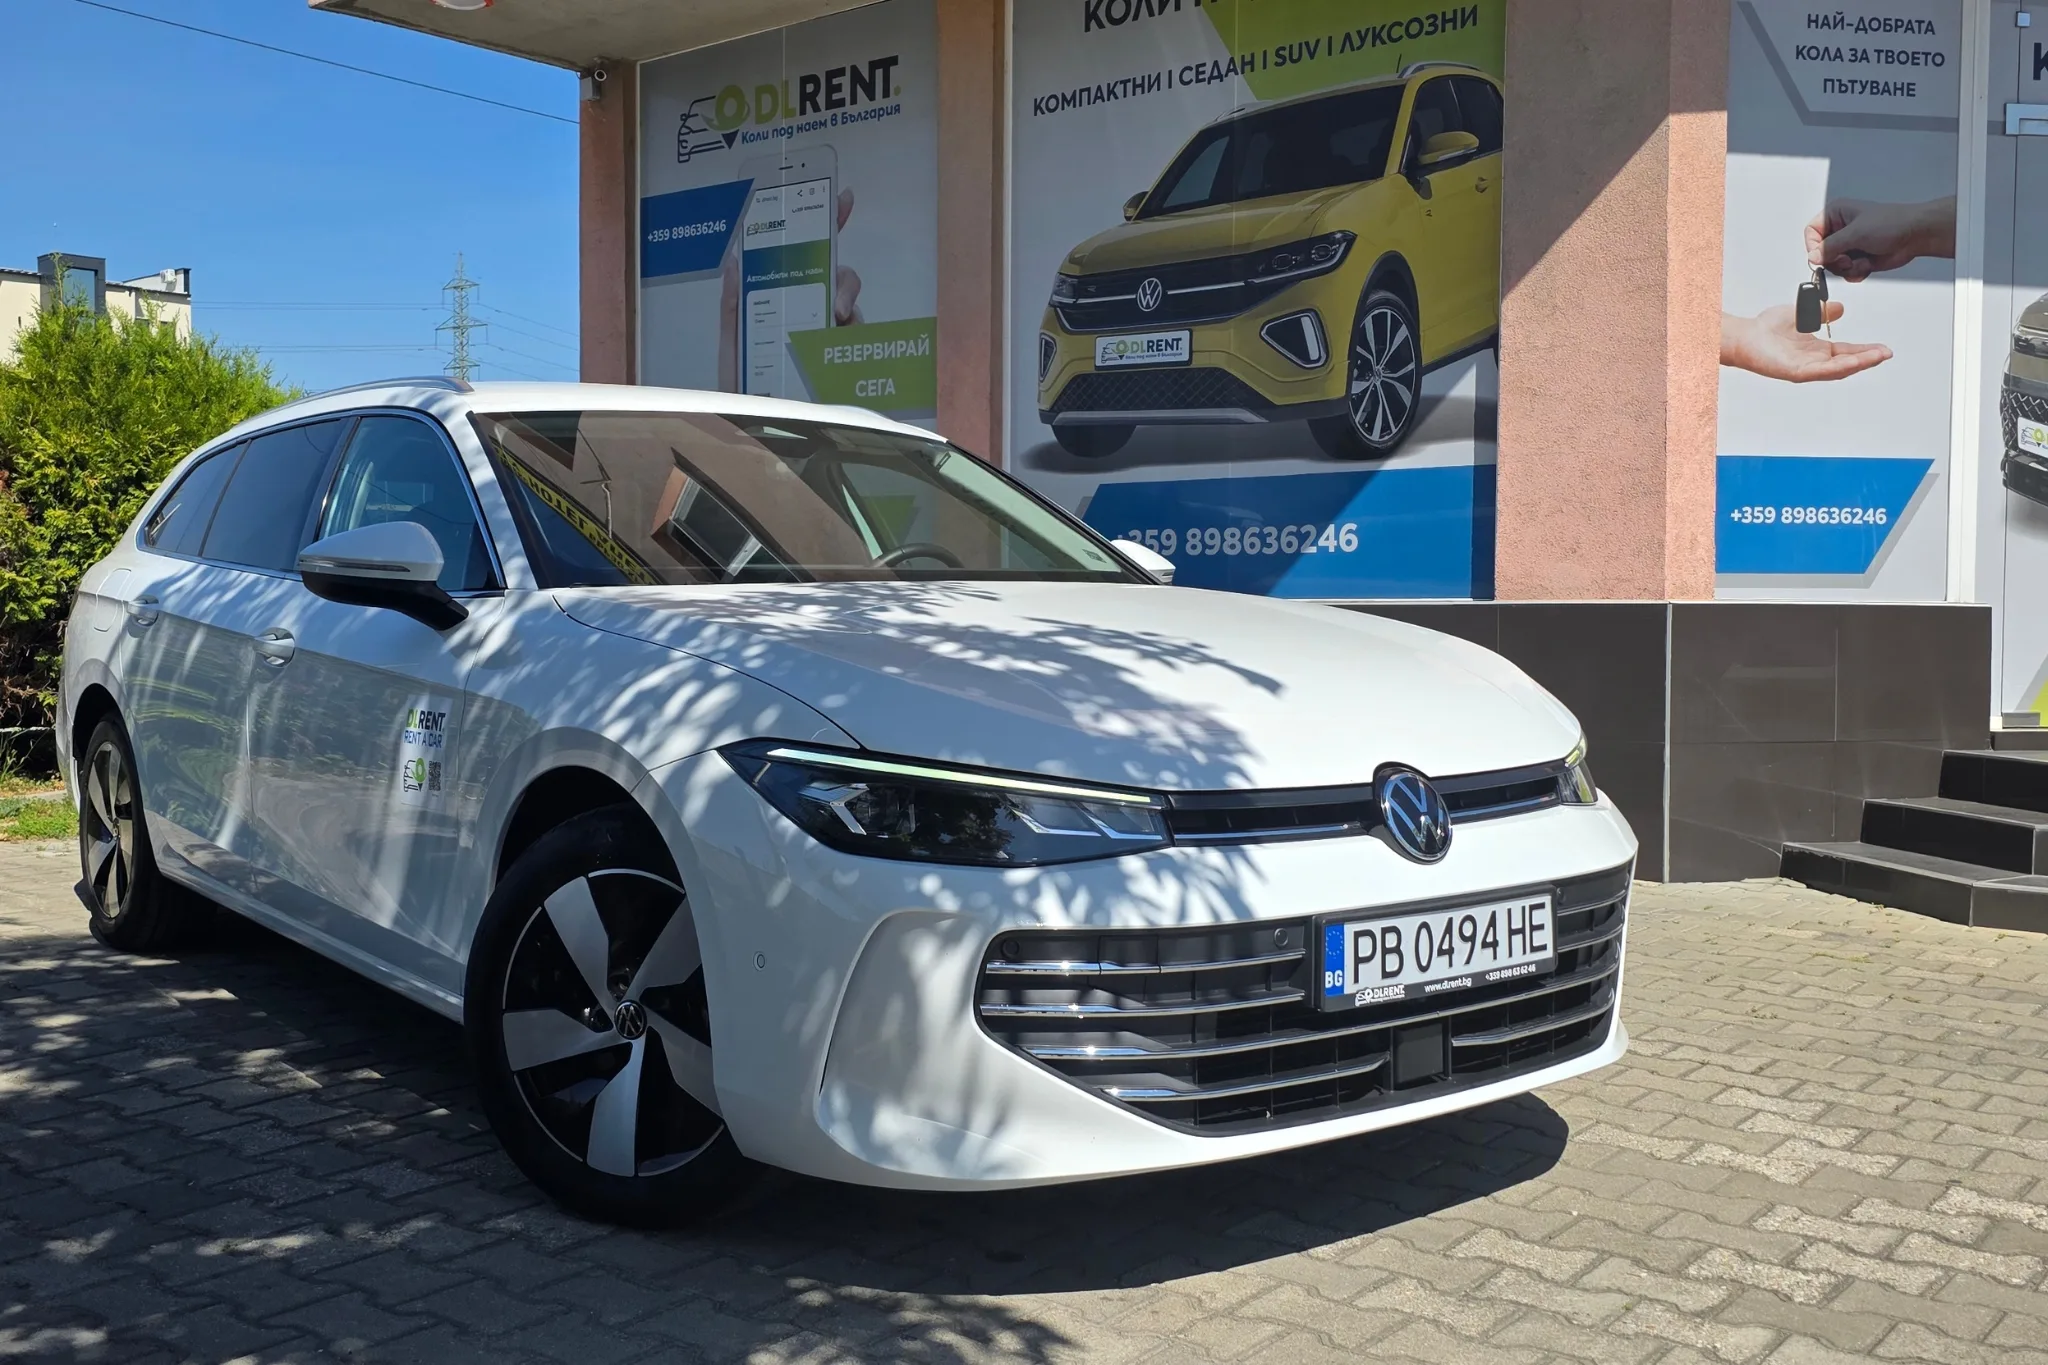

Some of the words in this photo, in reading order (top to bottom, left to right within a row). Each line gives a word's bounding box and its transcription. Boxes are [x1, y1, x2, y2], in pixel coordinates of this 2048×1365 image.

[1807, 11, 1936, 35] НАЙ-ДОБРАТА
[1033, 72, 1161, 117] КОМПАКТНИ
[1178, 52, 1255, 86] СЕДАН
[1274, 38, 1321, 67] SUV
[1339, 5, 1478, 54] ЛУКСОЗНИ
[1795, 45, 1844, 63] КОЛА
[1848, 48, 1870, 64] ЗА
[1874, 48, 1945, 67] ТВОЕТО
[1823, 78, 1917, 97] ПЪТУВАНЕ
[741, 130, 769, 144] Коли
[772, 123, 794, 139] под
[796, 118, 828, 133] наем
[841, 103, 901, 125] България
[647, 229, 670, 243] +359
[672, 219, 727, 240] 898636246
[823, 334, 930, 365] РЕЗЕРВИРАЙ
[855, 377, 896, 397] СЕГА
[1730, 505, 1777, 525] +359
[1781, 506, 1887, 526] 898636246
[1117, 528, 1177, 555] 359
[1185, 523, 1359, 556] 898636246
[404, 730, 421, 745] RENT
[421, 732, 427, 746] A
[428, 733, 443, 748] CAR
[1414, 910, 1499, 973] 0494
[1325, 969, 1343, 988] BG
[1512, 967, 1520, 976] 63
[1520, 966, 1528, 975] 62
